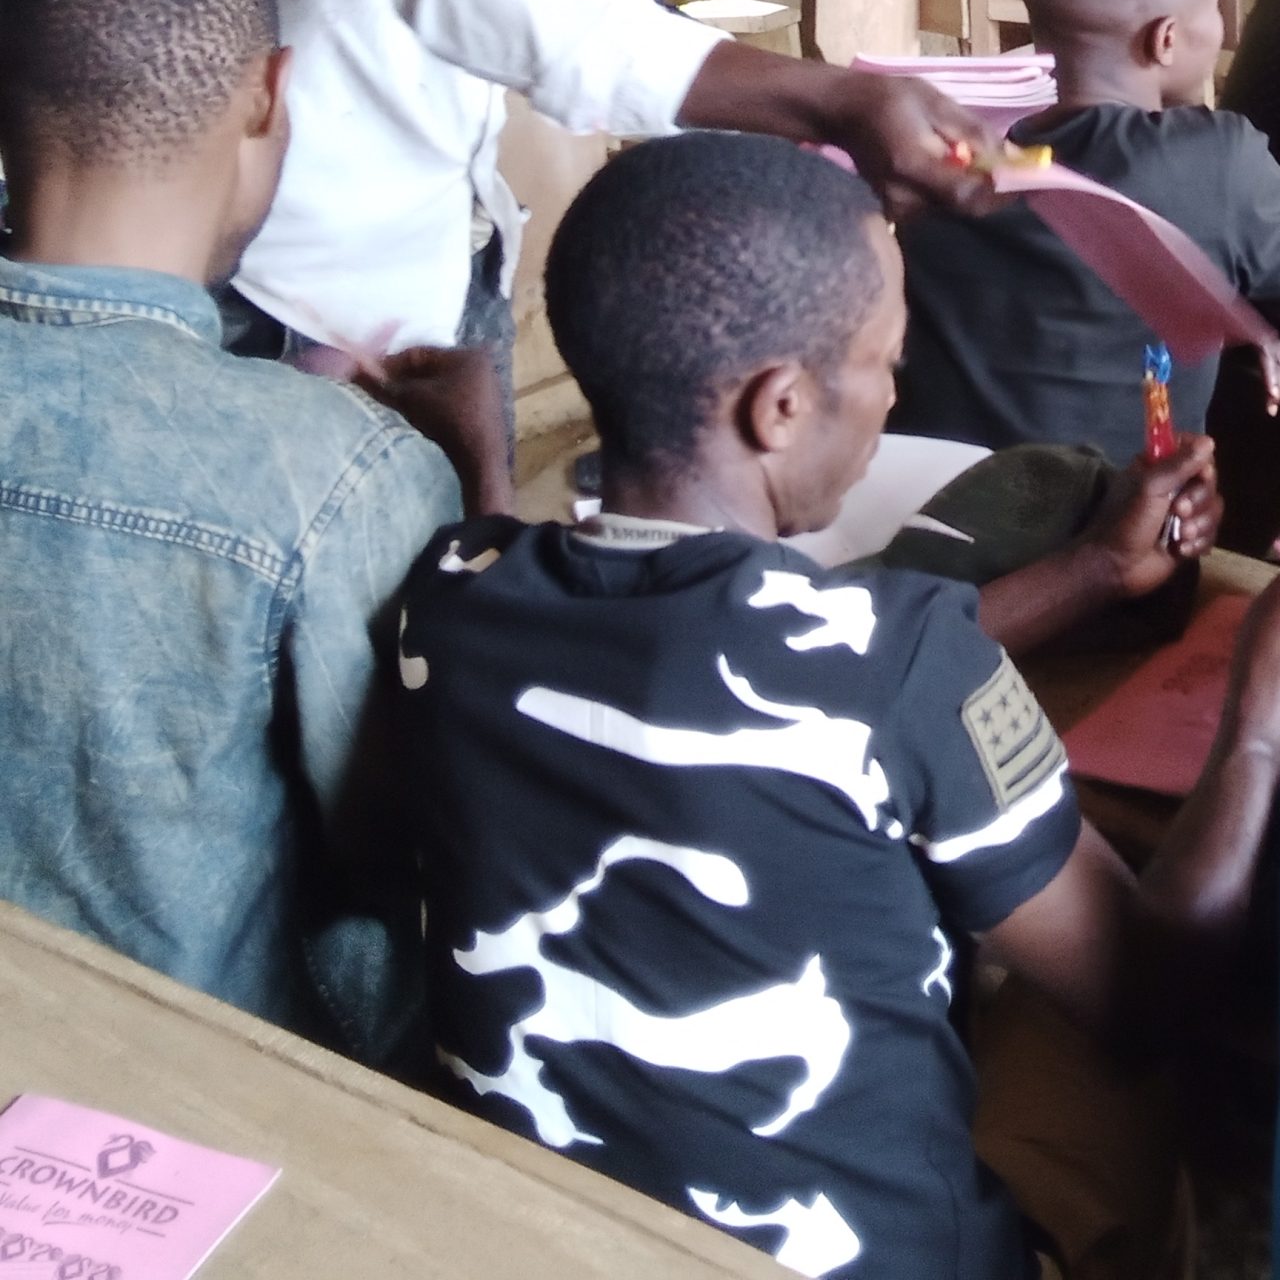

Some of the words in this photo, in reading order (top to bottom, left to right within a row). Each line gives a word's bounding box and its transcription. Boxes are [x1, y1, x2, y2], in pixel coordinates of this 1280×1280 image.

[0, 1155, 179, 1225] CROWNBIRD
[42, 1200, 71, 1222] for
[78, 1213, 134, 1235] money
